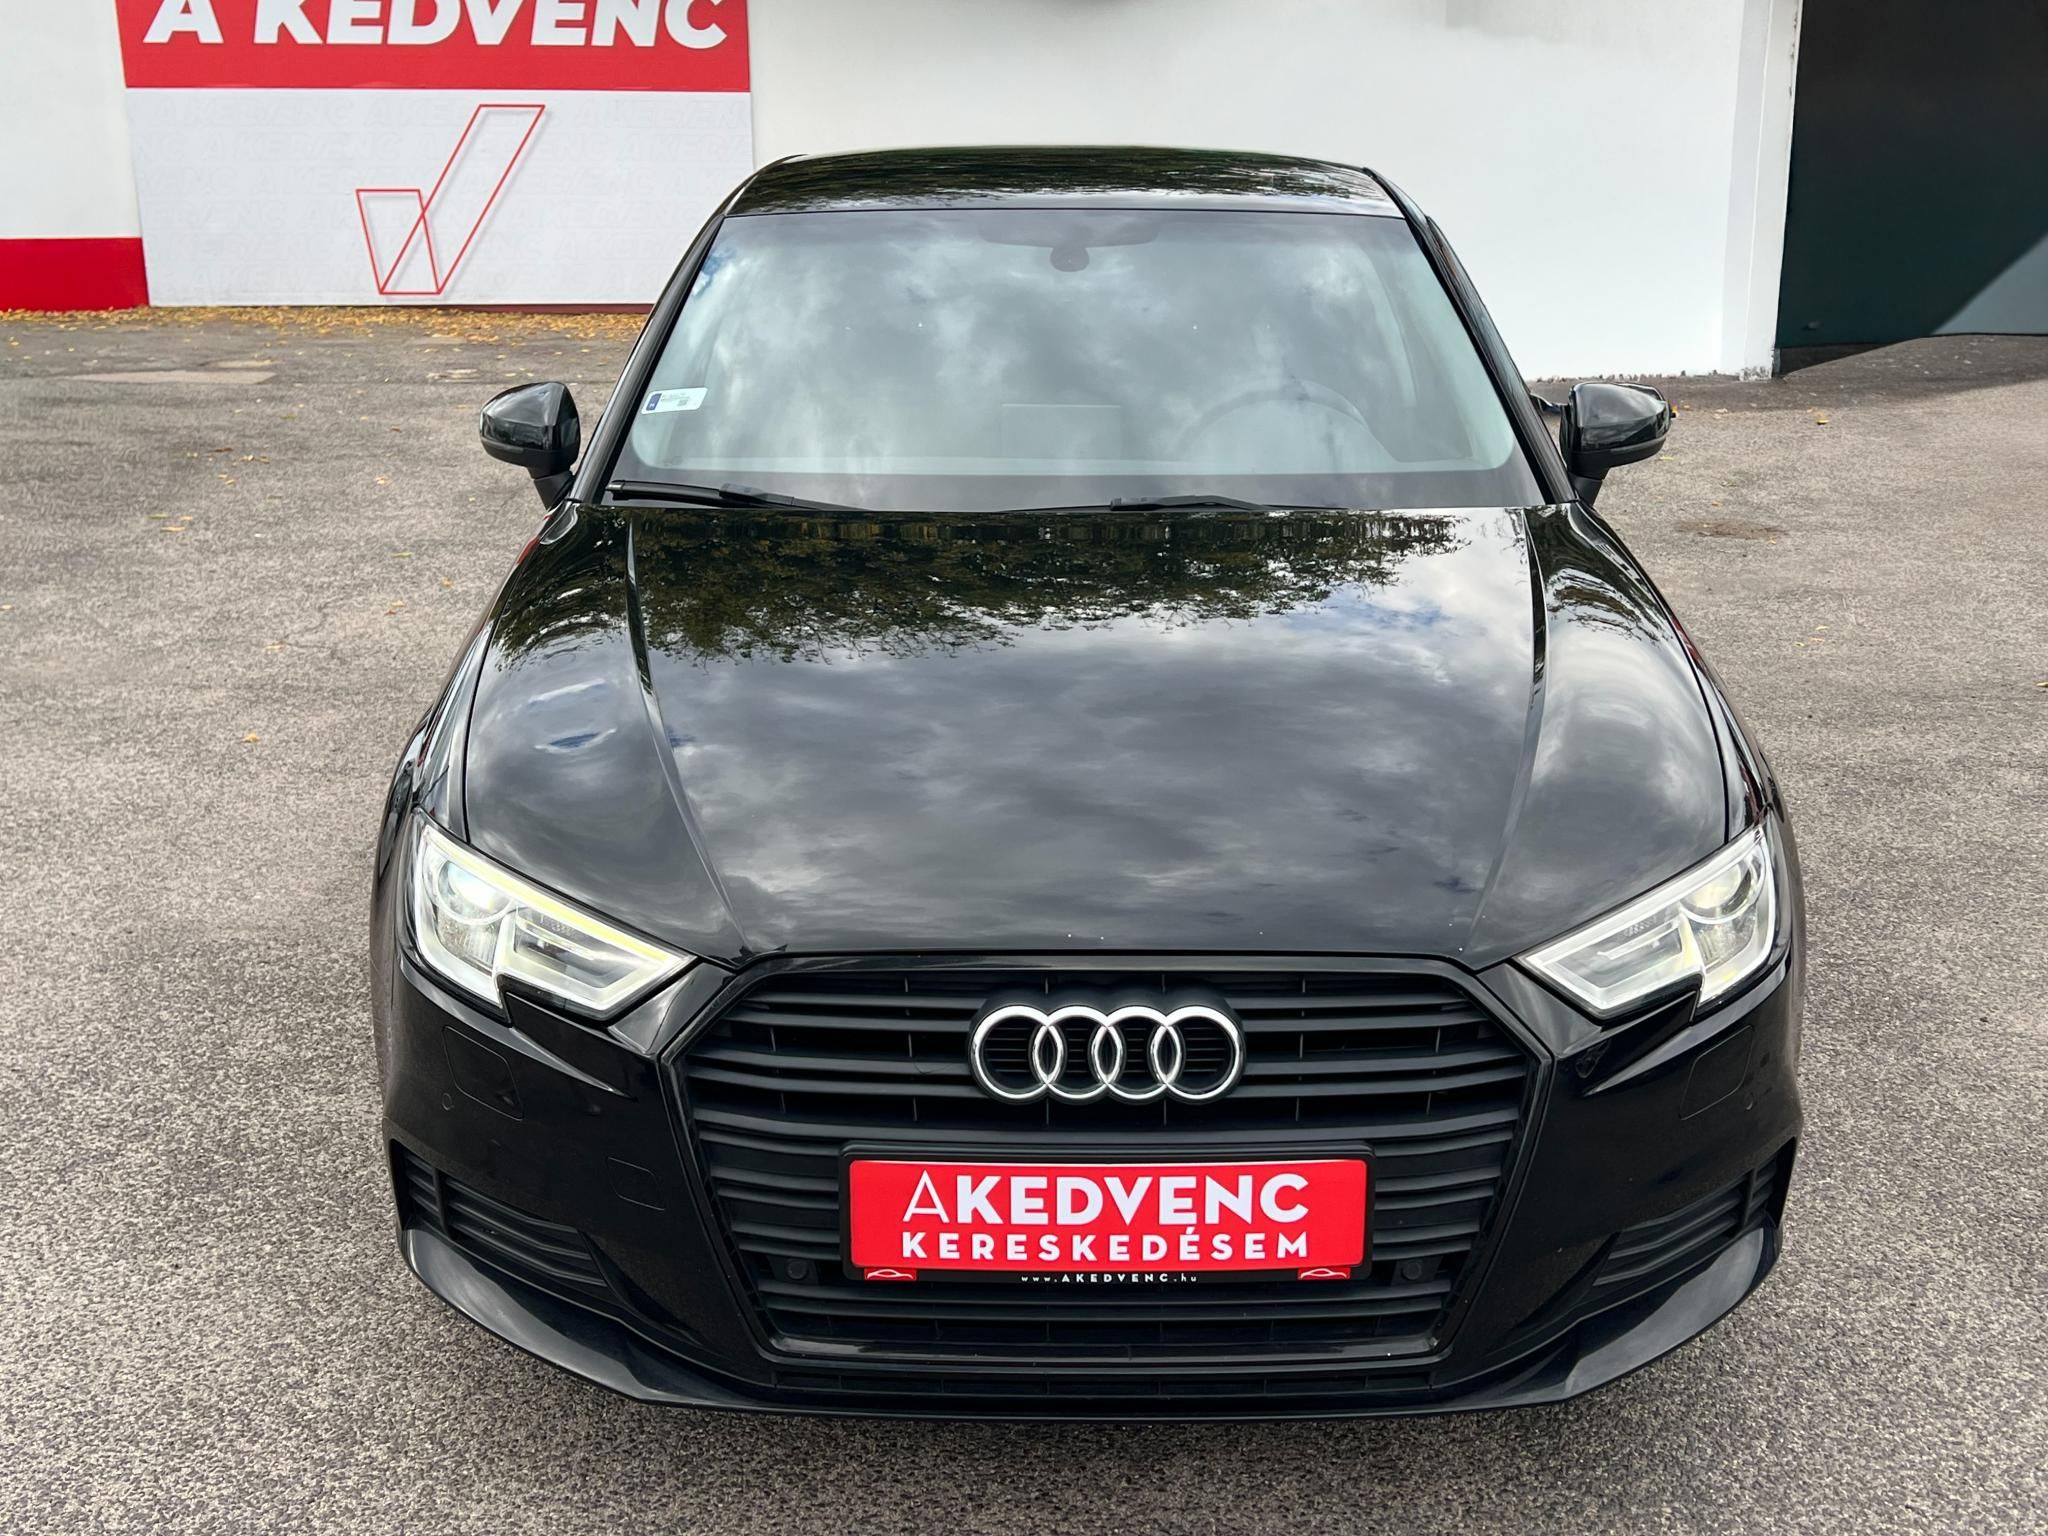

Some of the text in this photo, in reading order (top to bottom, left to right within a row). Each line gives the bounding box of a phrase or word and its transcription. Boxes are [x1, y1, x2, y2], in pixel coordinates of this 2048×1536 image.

[142, 0, 728, 49] A KEDVENC
[902, 1227, 1307, 1261] KERESKEDÉSEM
[1021, 1273, 1197, 1283] www.AKEDVENC.hu
